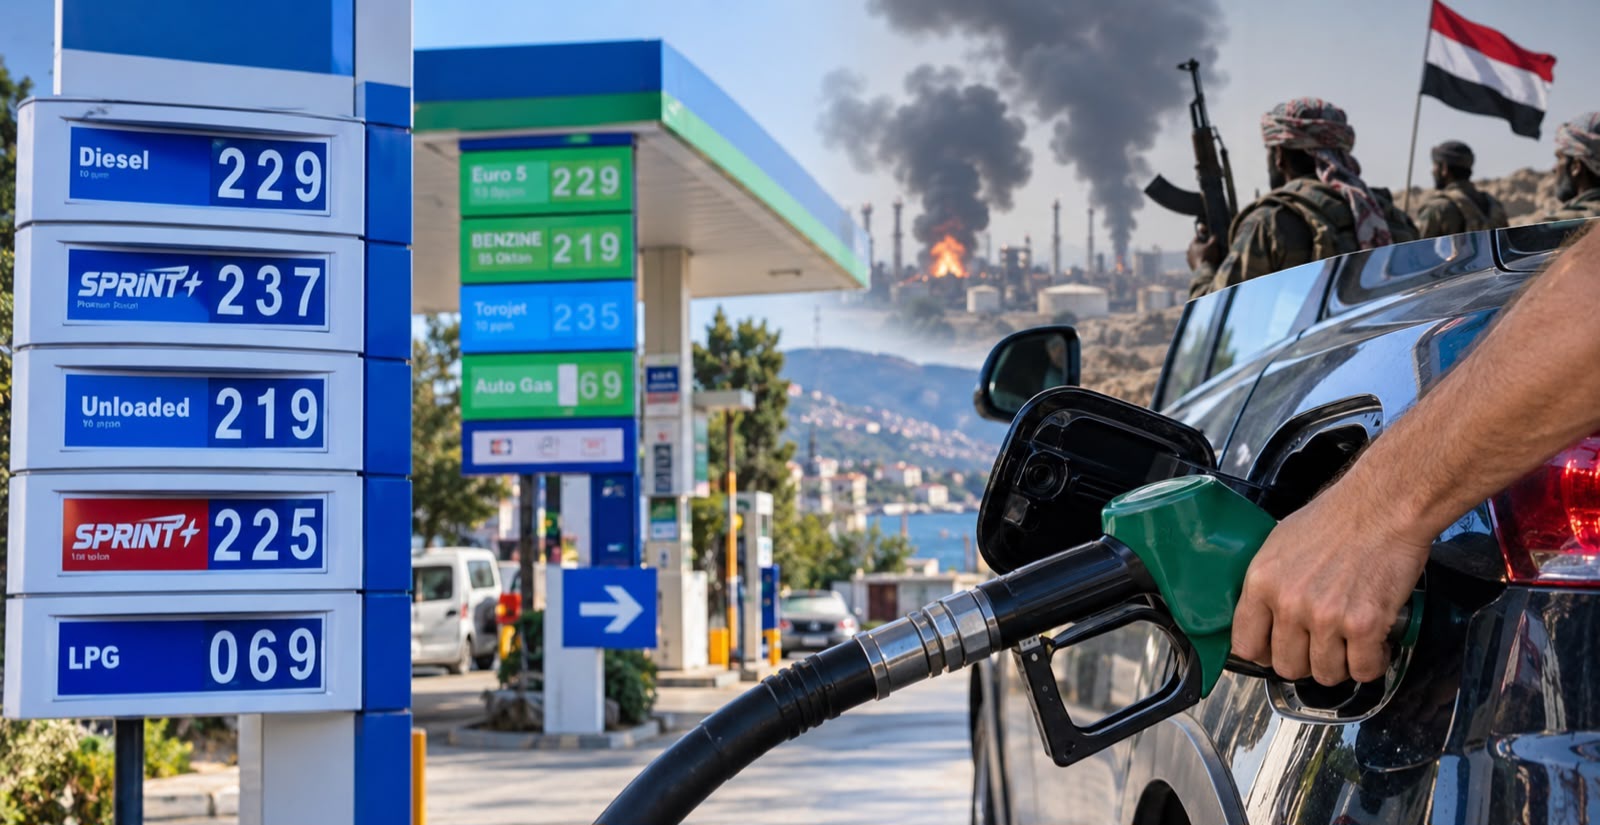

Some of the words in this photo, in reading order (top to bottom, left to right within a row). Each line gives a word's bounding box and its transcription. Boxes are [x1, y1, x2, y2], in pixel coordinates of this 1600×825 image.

[79, 147, 149, 170] Diesel
[217, 147, 322, 202] 229
[472, 166, 512, 183] Euro
[516, 165, 527, 182] 5
[553, 165, 620, 197] 229
[472, 231, 542, 249] BENZINE
[553, 232, 620, 264] 219
[217, 264, 321, 317] 237
[474, 301, 527, 319] Torojet
[553, 302, 620, 332] 235
[474, 378, 516, 394] Auto
[519, 377, 553, 394] Gas
[579, 371, 622, 400] 69
[81, 396, 190, 418] Unloaded
[215, 387, 318, 440] 219
[213, 508, 317, 561] 225
[68, 645, 120, 670] LPG
[209, 627, 316, 684] 069
